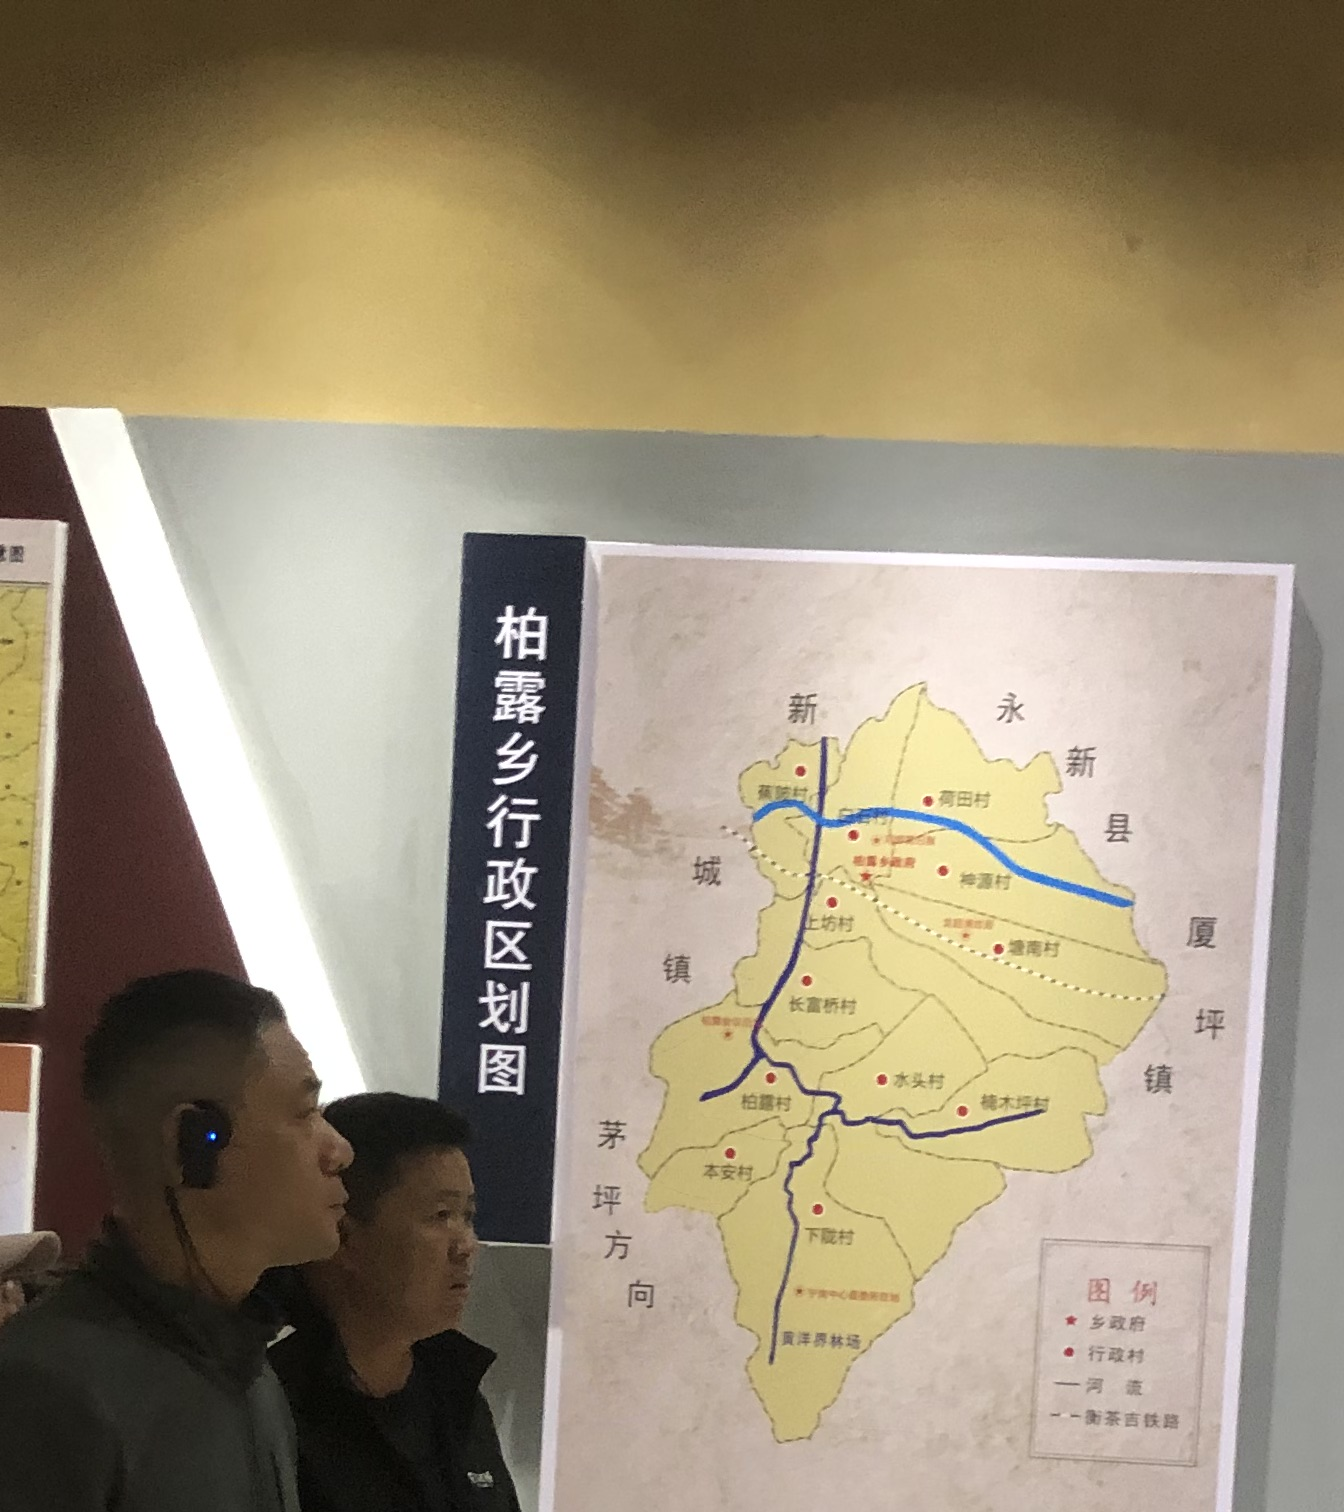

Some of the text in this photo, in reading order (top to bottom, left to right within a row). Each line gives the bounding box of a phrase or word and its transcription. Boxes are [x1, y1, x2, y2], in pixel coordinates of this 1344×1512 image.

[939, 790, 991, 809] 荷田村
[477, 605, 549, 1095] 柏露乡行政区划图
[805, 915, 855, 933] 上坊村
[789, 998, 857, 1016] 长富桥村
[894, 1073, 945, 1090] 水头村
[741, 1093, 792, 1112] 柏露村
[1088, 1278, 1158, 1306] 图例
[1089, 1314, 1146, 1333] 乡政府
[782, 1330, 862, 1350] 黄洋界林场
[1088, 1345, 1145, 1365] 行政村
[1085, 1377, 1144, 1396] 河流
[1084, 1409, 1180, 1429] 衡茶吉铁路
